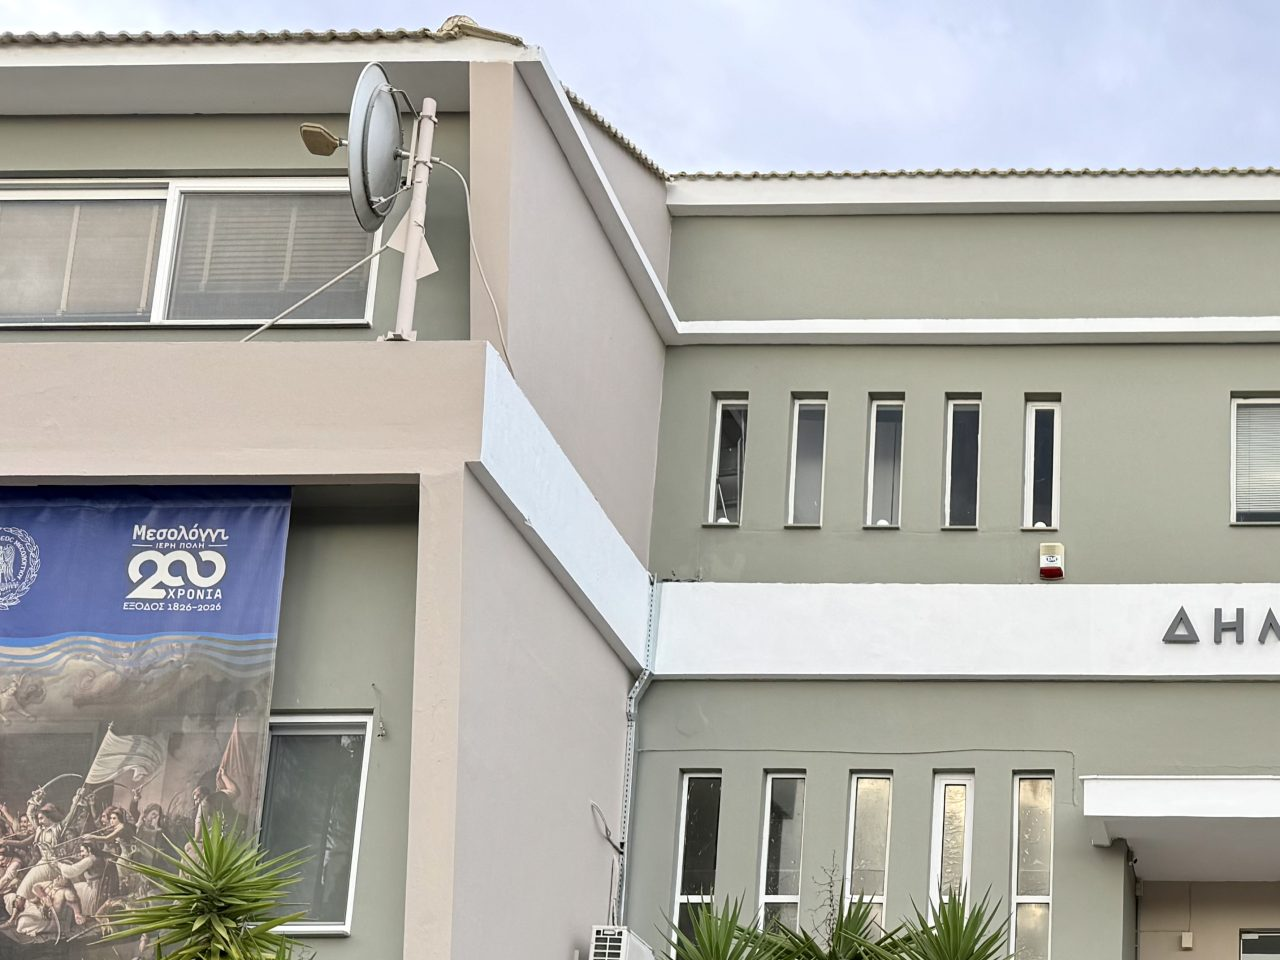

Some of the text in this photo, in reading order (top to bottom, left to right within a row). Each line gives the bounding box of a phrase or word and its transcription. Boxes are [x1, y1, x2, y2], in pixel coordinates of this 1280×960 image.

[132, 523, 229, 543] Μεσολόγγι
[167, 588, 222, 600] ΧΡΟΝΙΑ
[122, 602, 165, 611] ΕΞΟΔΟΣ
